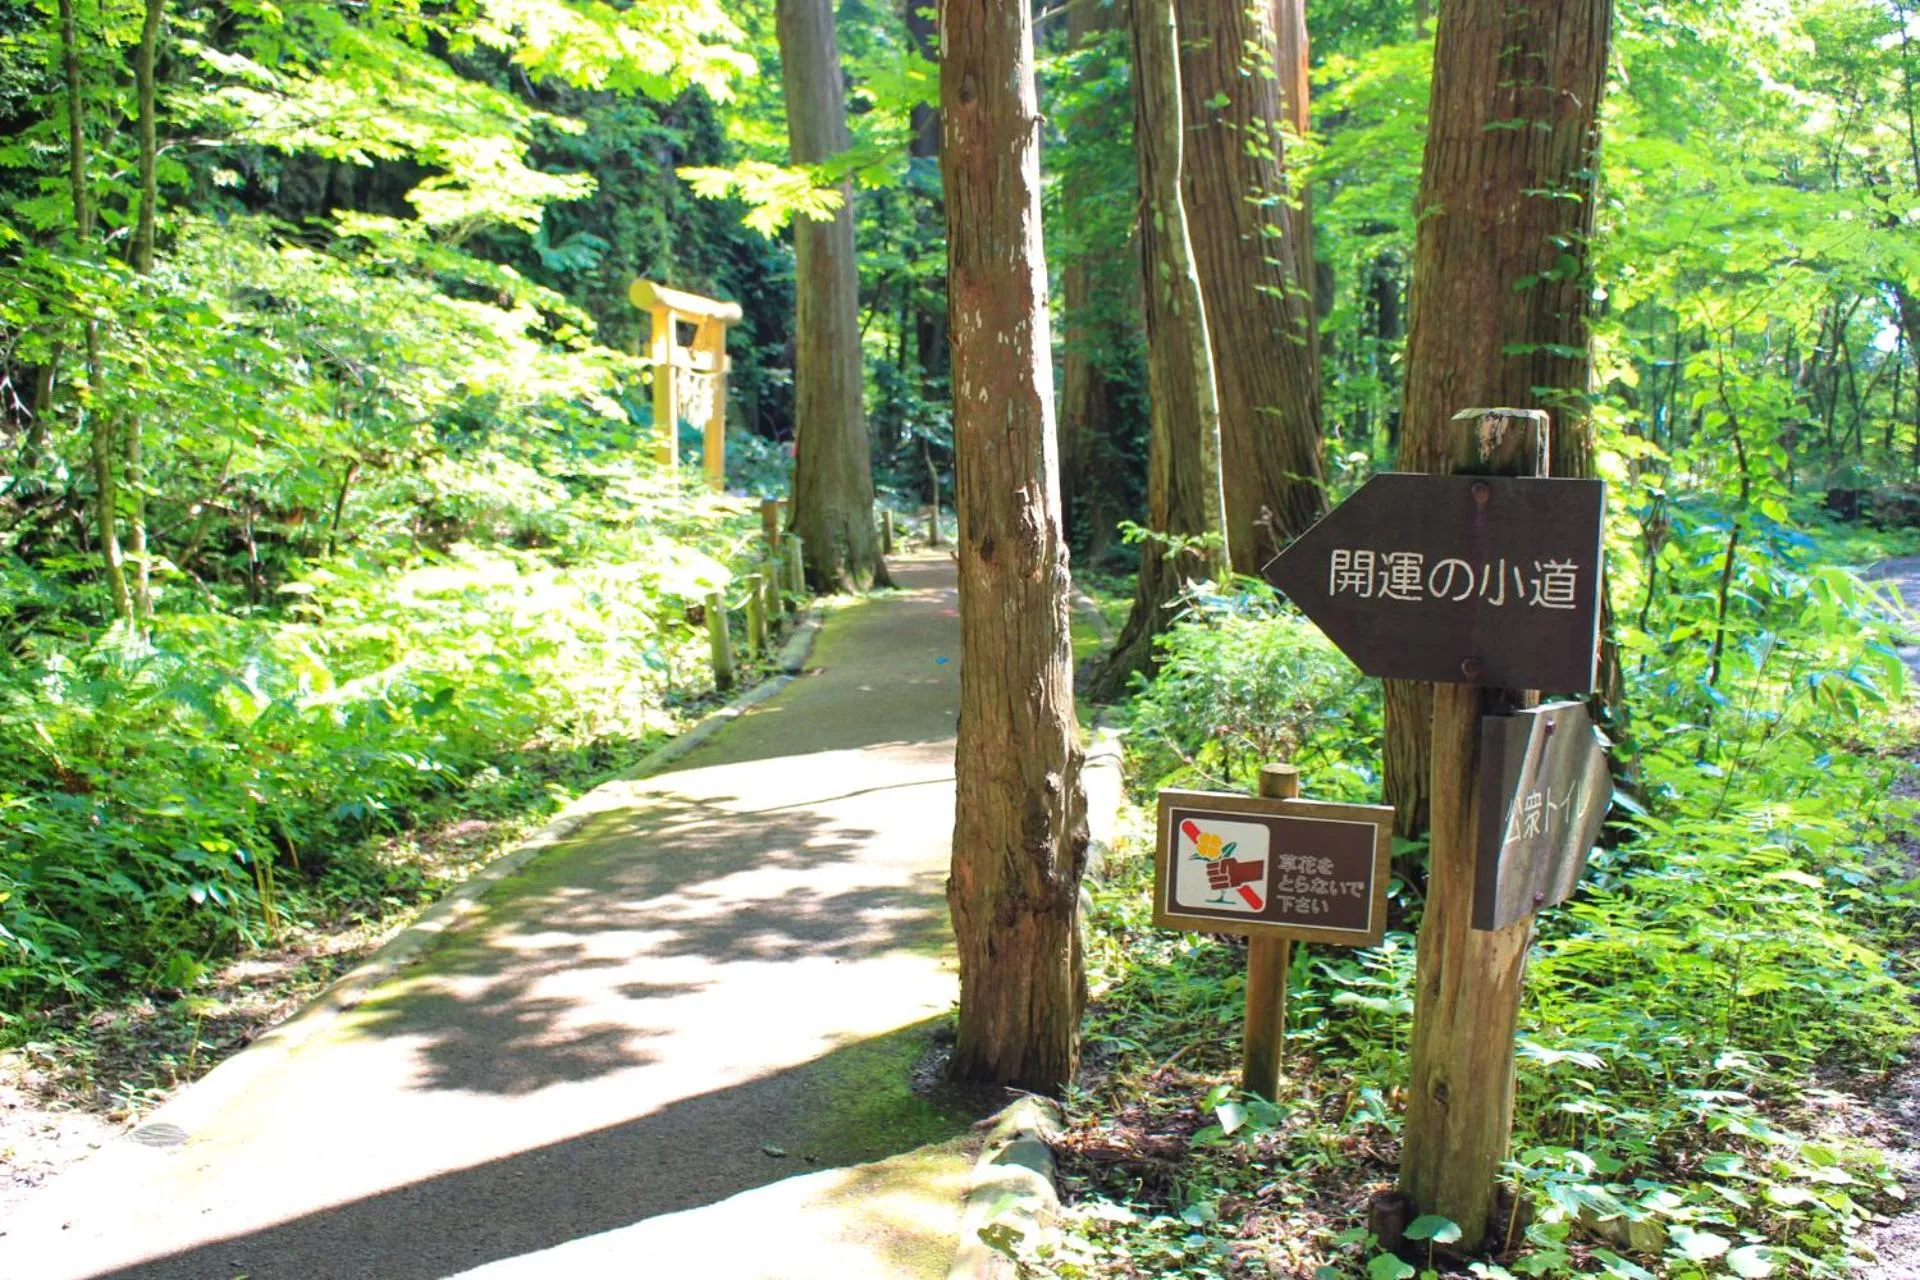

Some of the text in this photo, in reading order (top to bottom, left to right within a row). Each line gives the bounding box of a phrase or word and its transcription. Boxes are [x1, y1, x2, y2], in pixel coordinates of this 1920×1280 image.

[1329, 549, 1580, 610] 開運の小道
[1505, 780, 1591, 845] 公衆トイレ
[1277, 853, 1335, 875] 草花を
[1277, 874, 1364, 898] とらないで
[1276, 894, 1329, 914] 下さい
